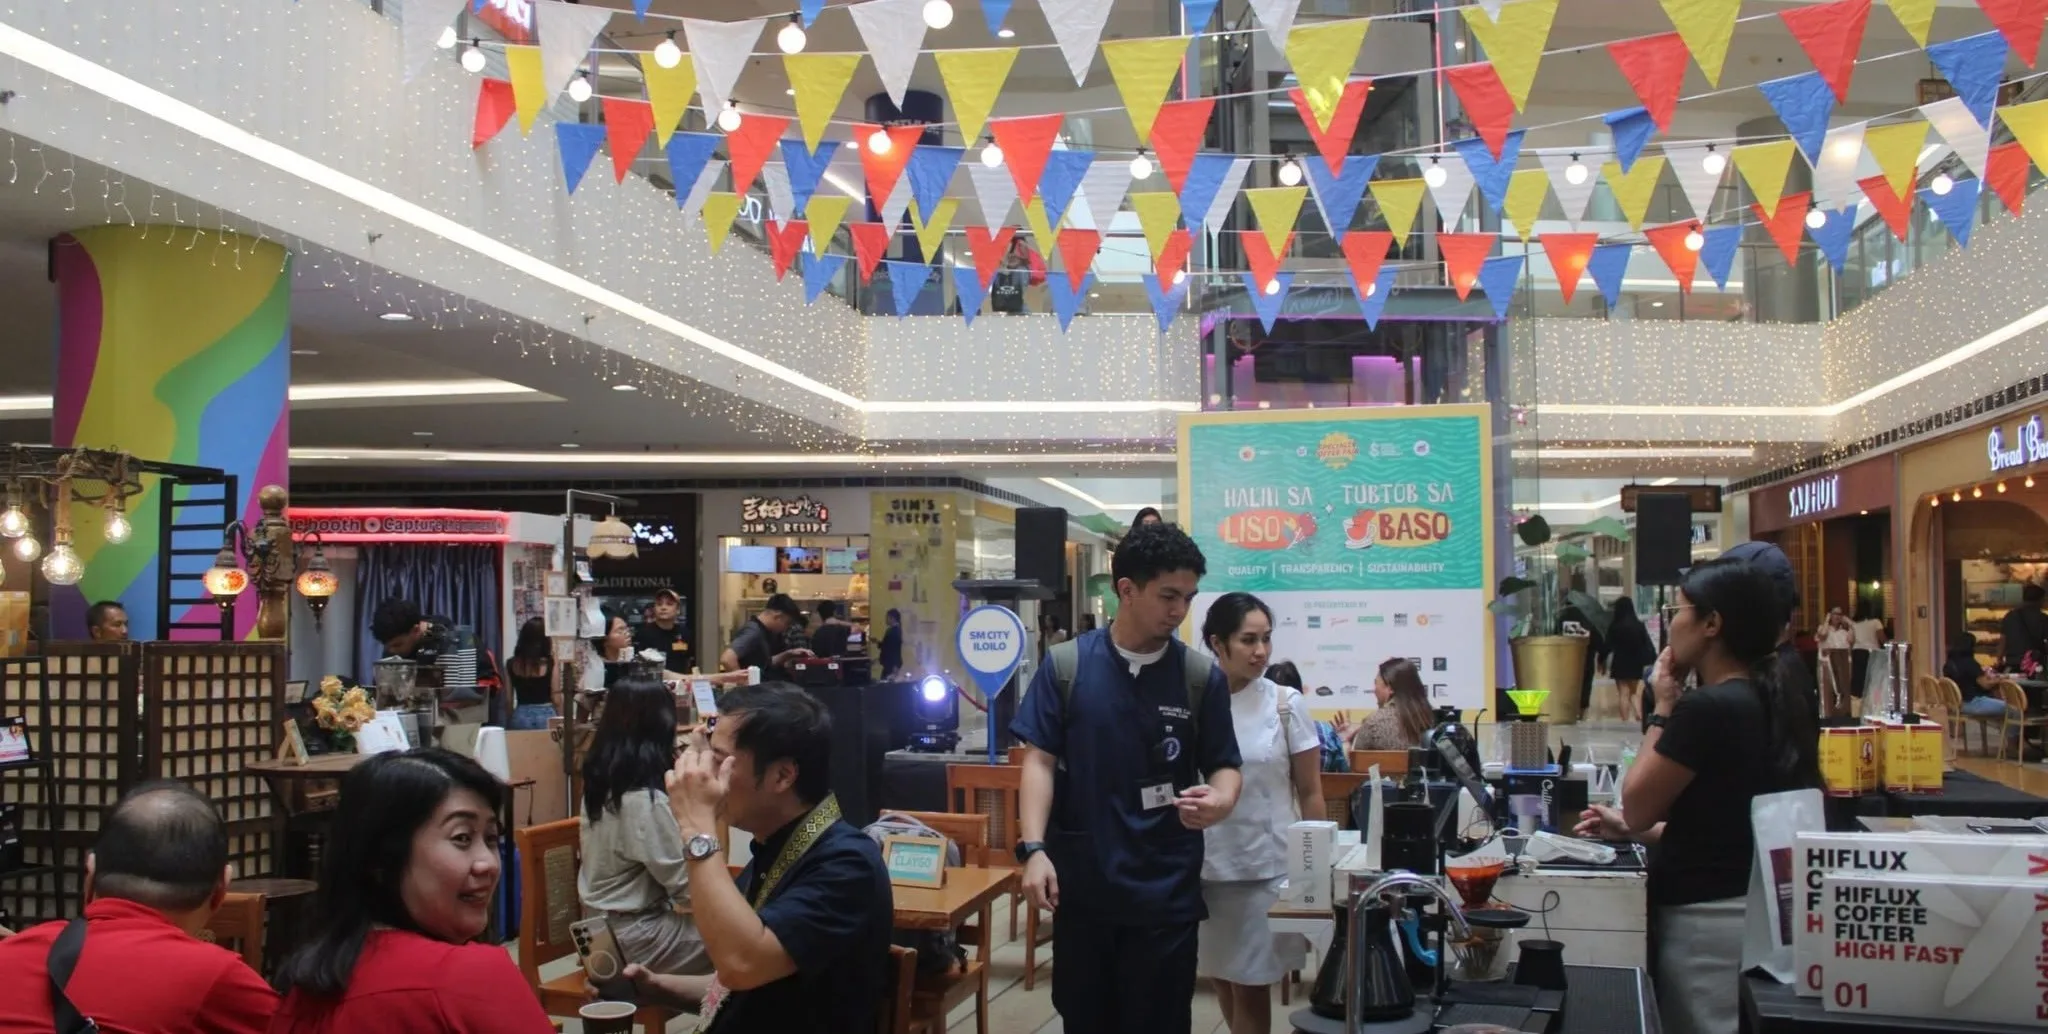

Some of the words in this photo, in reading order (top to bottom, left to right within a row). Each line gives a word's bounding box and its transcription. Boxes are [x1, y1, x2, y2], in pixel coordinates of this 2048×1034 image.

[1988, 427, 2023, 471] Bread
[1287, 486, 1313, 506] SA
[1427, 482, 1454, 503] SA
[309, 518, 360, 532] booth
[742, 523, 777, 533] JIM'S
[783, 523, 829, 533] RECIPE
[1224, 516, 1280, 543] LISO
[1378, 512, 1449, 540] BASO
[1228, 566, 1267, 576] QUALITY
[1281, 564, 1353, 574] TRANSPARENCY
[1367, 562, 1445, 573] SUSTAINABILITY
[593, 576, 674, 588] RADITIONAL
[970, 631, 986, 640] SM
[987, 631, 1009, 640] CITY
[973, 642, 1006, 651] ILOILO
[1303, 832, 1313, 871] HIFLUX
[1807, 848, 1908, 871] HIFLUX
[1835, 886, 1921, 906] HIFLUX
[1834, 905, 1927, 925] COFFEE
[1835, 923, 1915, 943] FILTER
[1835, 941, 1895, 961] HIGH
[1904, 945, 1965, 965] FAST
[1834, 981, 1868, 1009] 01
